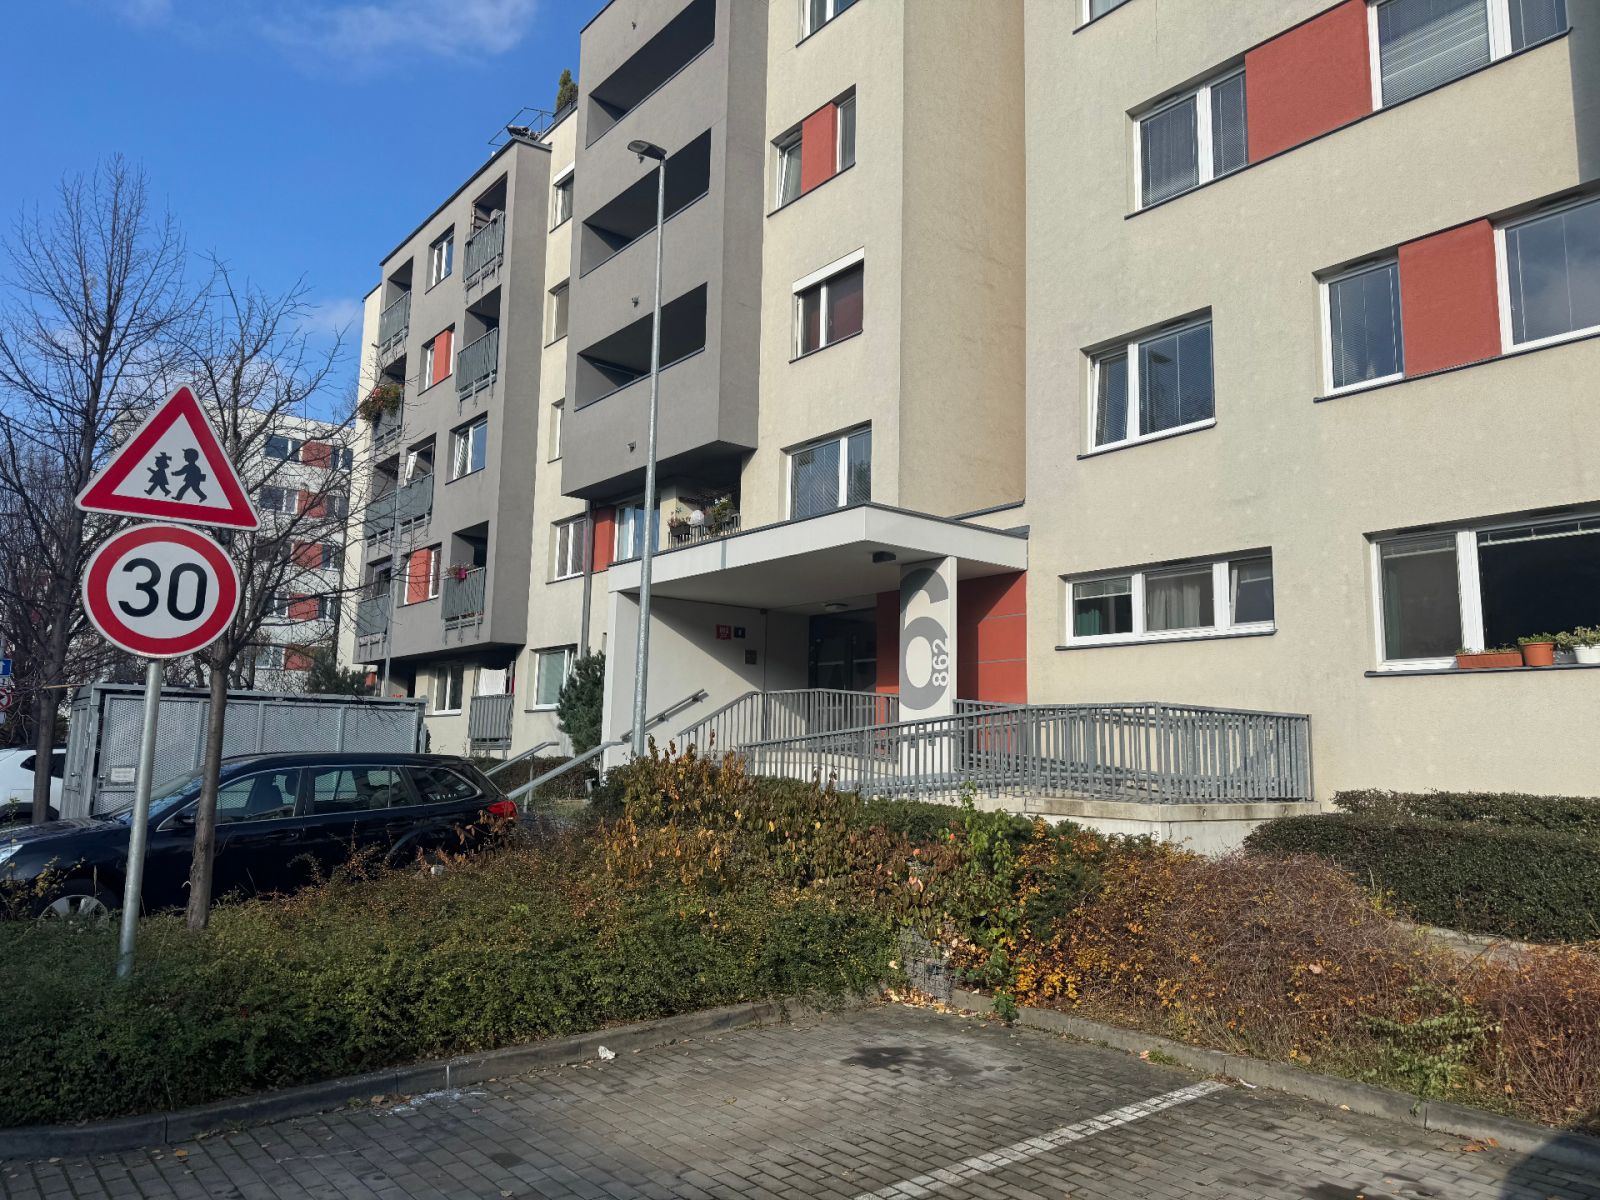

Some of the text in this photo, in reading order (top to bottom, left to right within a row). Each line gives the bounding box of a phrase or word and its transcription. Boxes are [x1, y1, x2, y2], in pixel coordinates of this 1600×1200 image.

[118, 557, 208, 621] 30
[899, 567, 949, 710] 6
[932, 638, 949, 687] 862
